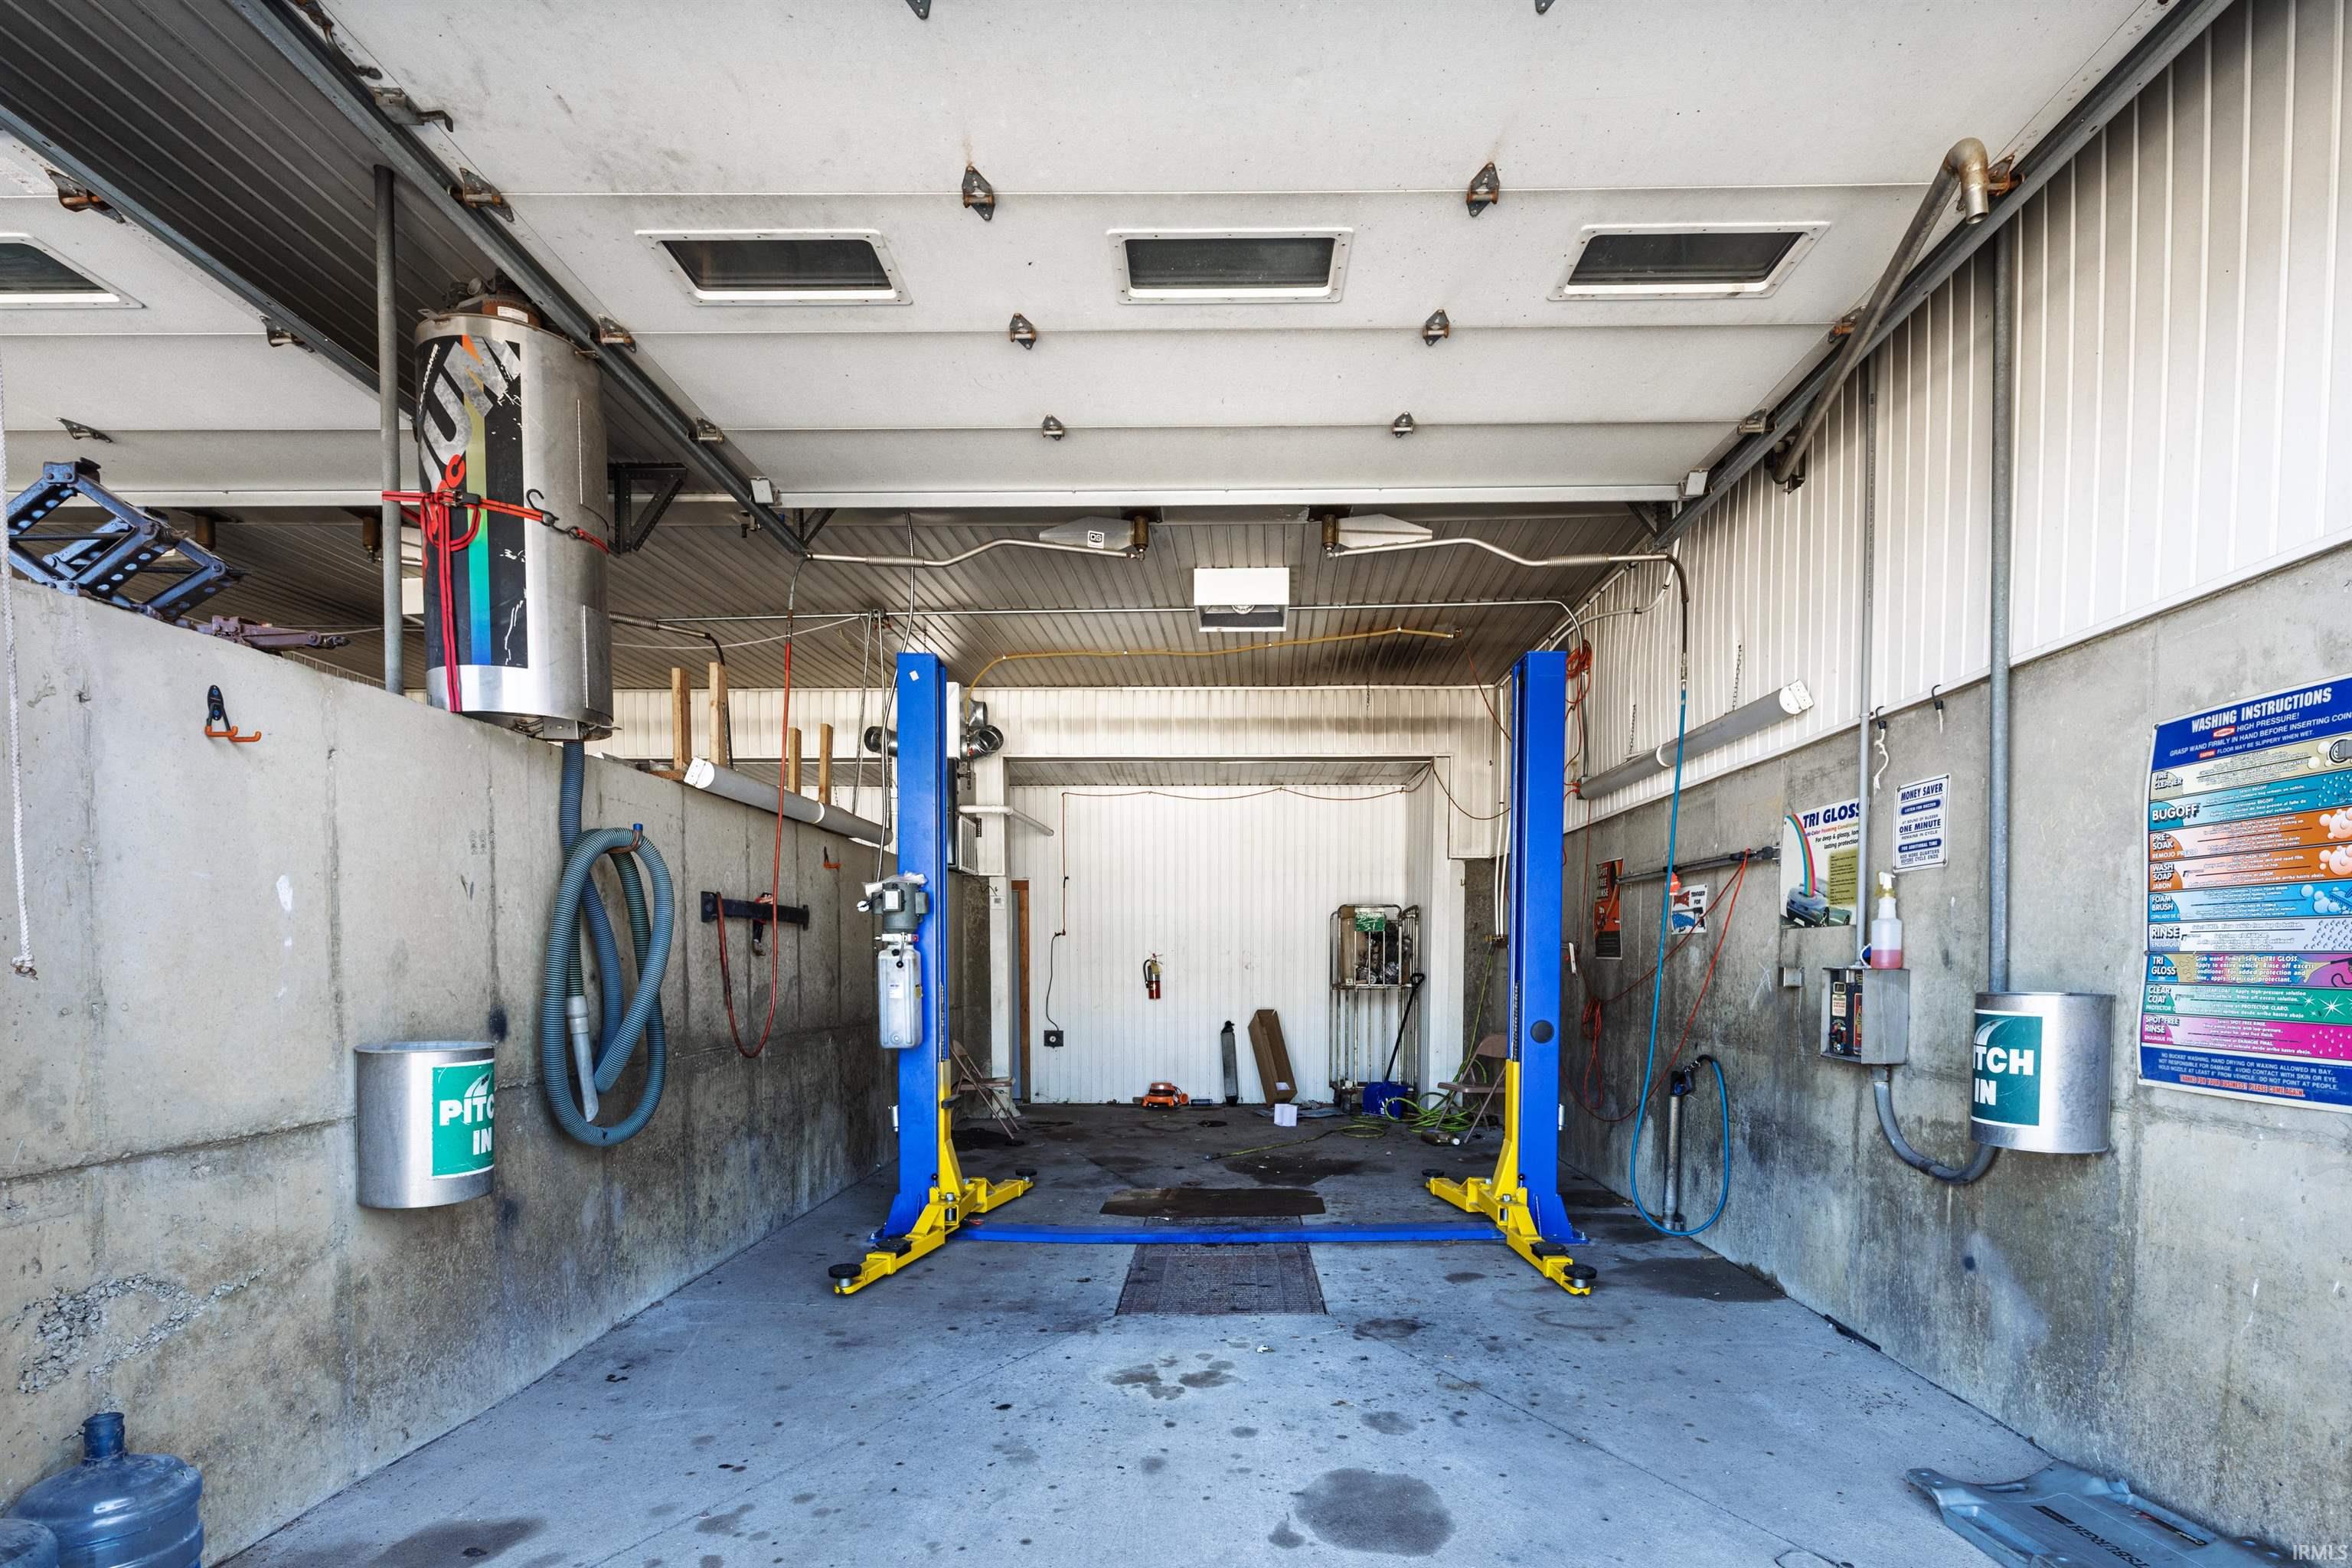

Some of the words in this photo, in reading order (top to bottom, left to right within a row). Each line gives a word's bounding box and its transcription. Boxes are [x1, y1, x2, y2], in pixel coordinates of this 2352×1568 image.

[1089, 533, 1102, 542] DS
[2192, 710, 2237, 733] WASHING
[2241, 687, 2332, 721] INSTRUCTIONS
[2237, 722, 2254, 732] HIGH
[2256, 712, 2300, 728] PRESSURE!
[2170, 746, 2189, 756] GRASP
[2190, 743, 2207, 752] WAND
[2208, 737, 2230, 748] FIRMLY
[2239, 732, 2258, 741] HAND
[2259, 725, 2288, 737] BEFORE
[2289, 716, 2330, 730] INSERTING
[2255, 737, 2281, 746] SLIPPERY
[2154, 777, 2183, 789] CLEANER
[2156, 772, 2168, 781] TIRE
[1901, 788, 1921, 802] MONEY
[1923, 782, 1943, 796] SAVER
[1803, 812, 1819, 828] TRI
[2152, 804, 2200, 822] BUGOFF
[1900, 825, 1912, 833] ONE
[1914, 818, 1941, 831] MINUTE
[1837, 831, 1850, 840] glossy,
[2152, 833, 2171, 842] PRE-
[2152, 841, 2174, 851] SOAK
[2153, 873, 2173, 881] SOAP
[2151, 926, 2180, 939] RINSE
[2152, 956, 2164, 965] TRI
[2147, 995, 2167, 1004] COAT
[2145, 1016, 2180, 1026] SPOT-FREE
[2145, 1025, 2166, 1034] RINSE
[1973, 1046, 2035, 1076] ITCH
[2197, 1076, 2207, 1085] FOR
[2207, 1078, 2220, 1086] YOUR
[2220, 1080, 2248, 1090] BUSINESS!
[2249, 1083, 2268, 1093] PLEASE
[2268, 1086, 2285, 1094] COME
[2284, 1087, 2306, 1098] AGAIN.
[2233, 1073, 2256, 1082] VEHICLE.
[2312, 1082, 2339, 1090] PEOPLE.
[1975, 1078, 1997, 1106] IN
[439, 1093, 495, 1126] PITC
[472, 1127, 492, 1155] IN
